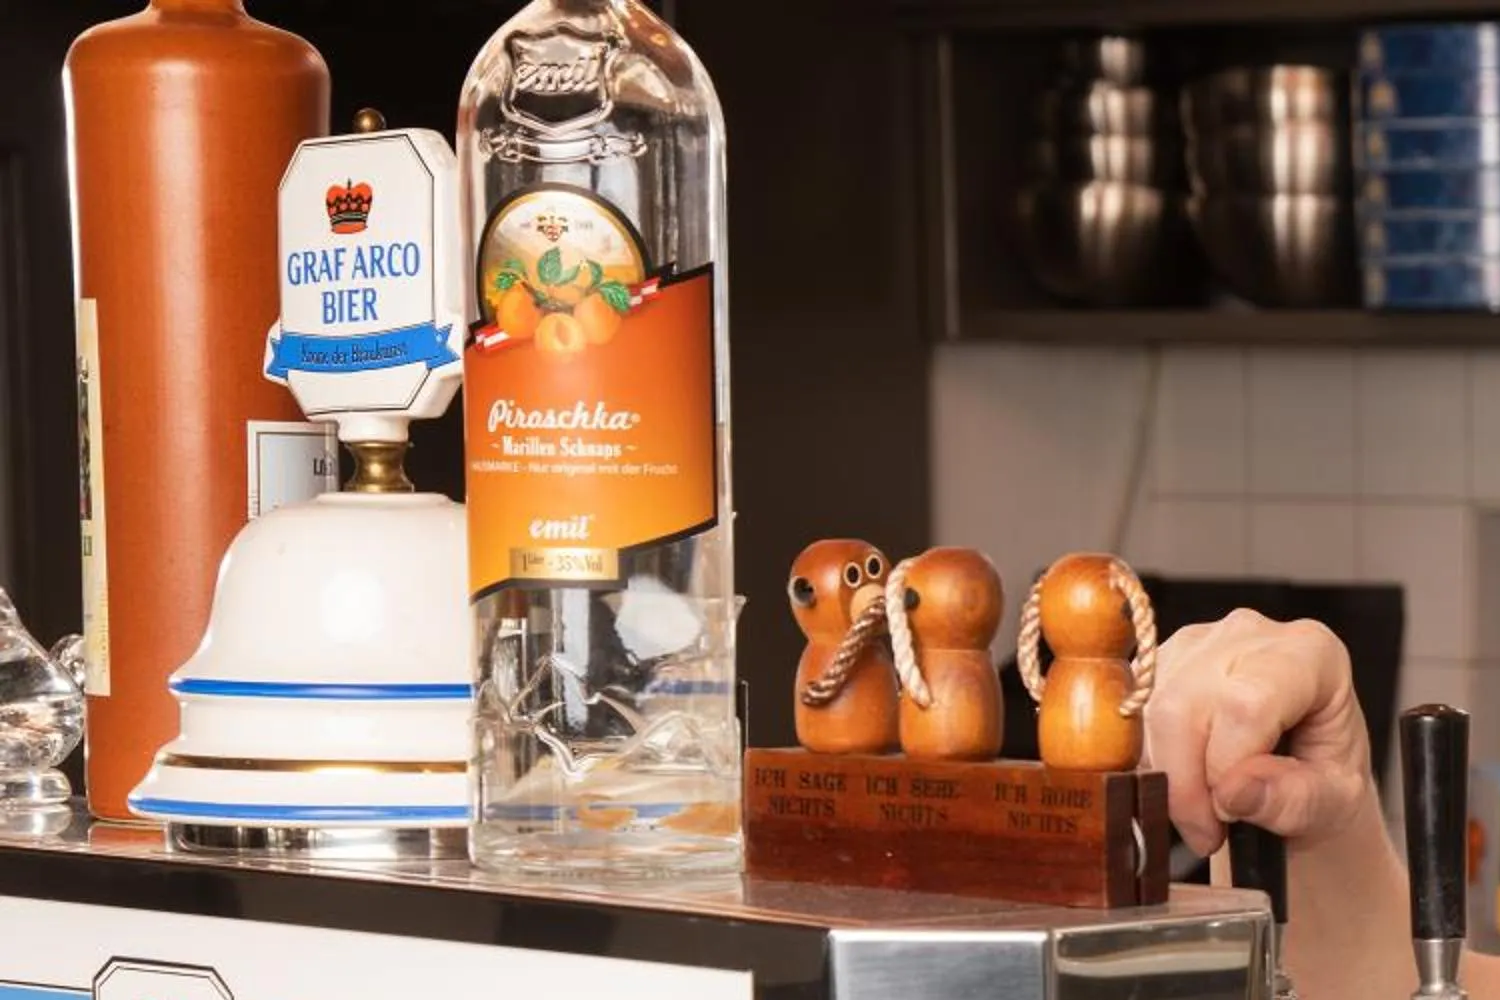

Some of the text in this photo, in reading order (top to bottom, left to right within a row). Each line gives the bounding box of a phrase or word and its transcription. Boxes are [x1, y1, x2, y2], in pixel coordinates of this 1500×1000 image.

[287, 242, 421, 286] GRAF ARCO
[322, 287, 379, 324] BIER
[559, 436, 622, 460] Schnaps
[528, 514, 590, 540] emil
[755, 768, 847, 793] ICH SAGE
[866, 774, 899, 797] ICH
[994, 782, 1028, 804] ICH
[767, 795, 836, 818] NICHTS
[879, 803, 950, 826] NICHTS
[1007, 810, 1078, 834] NICHTS
